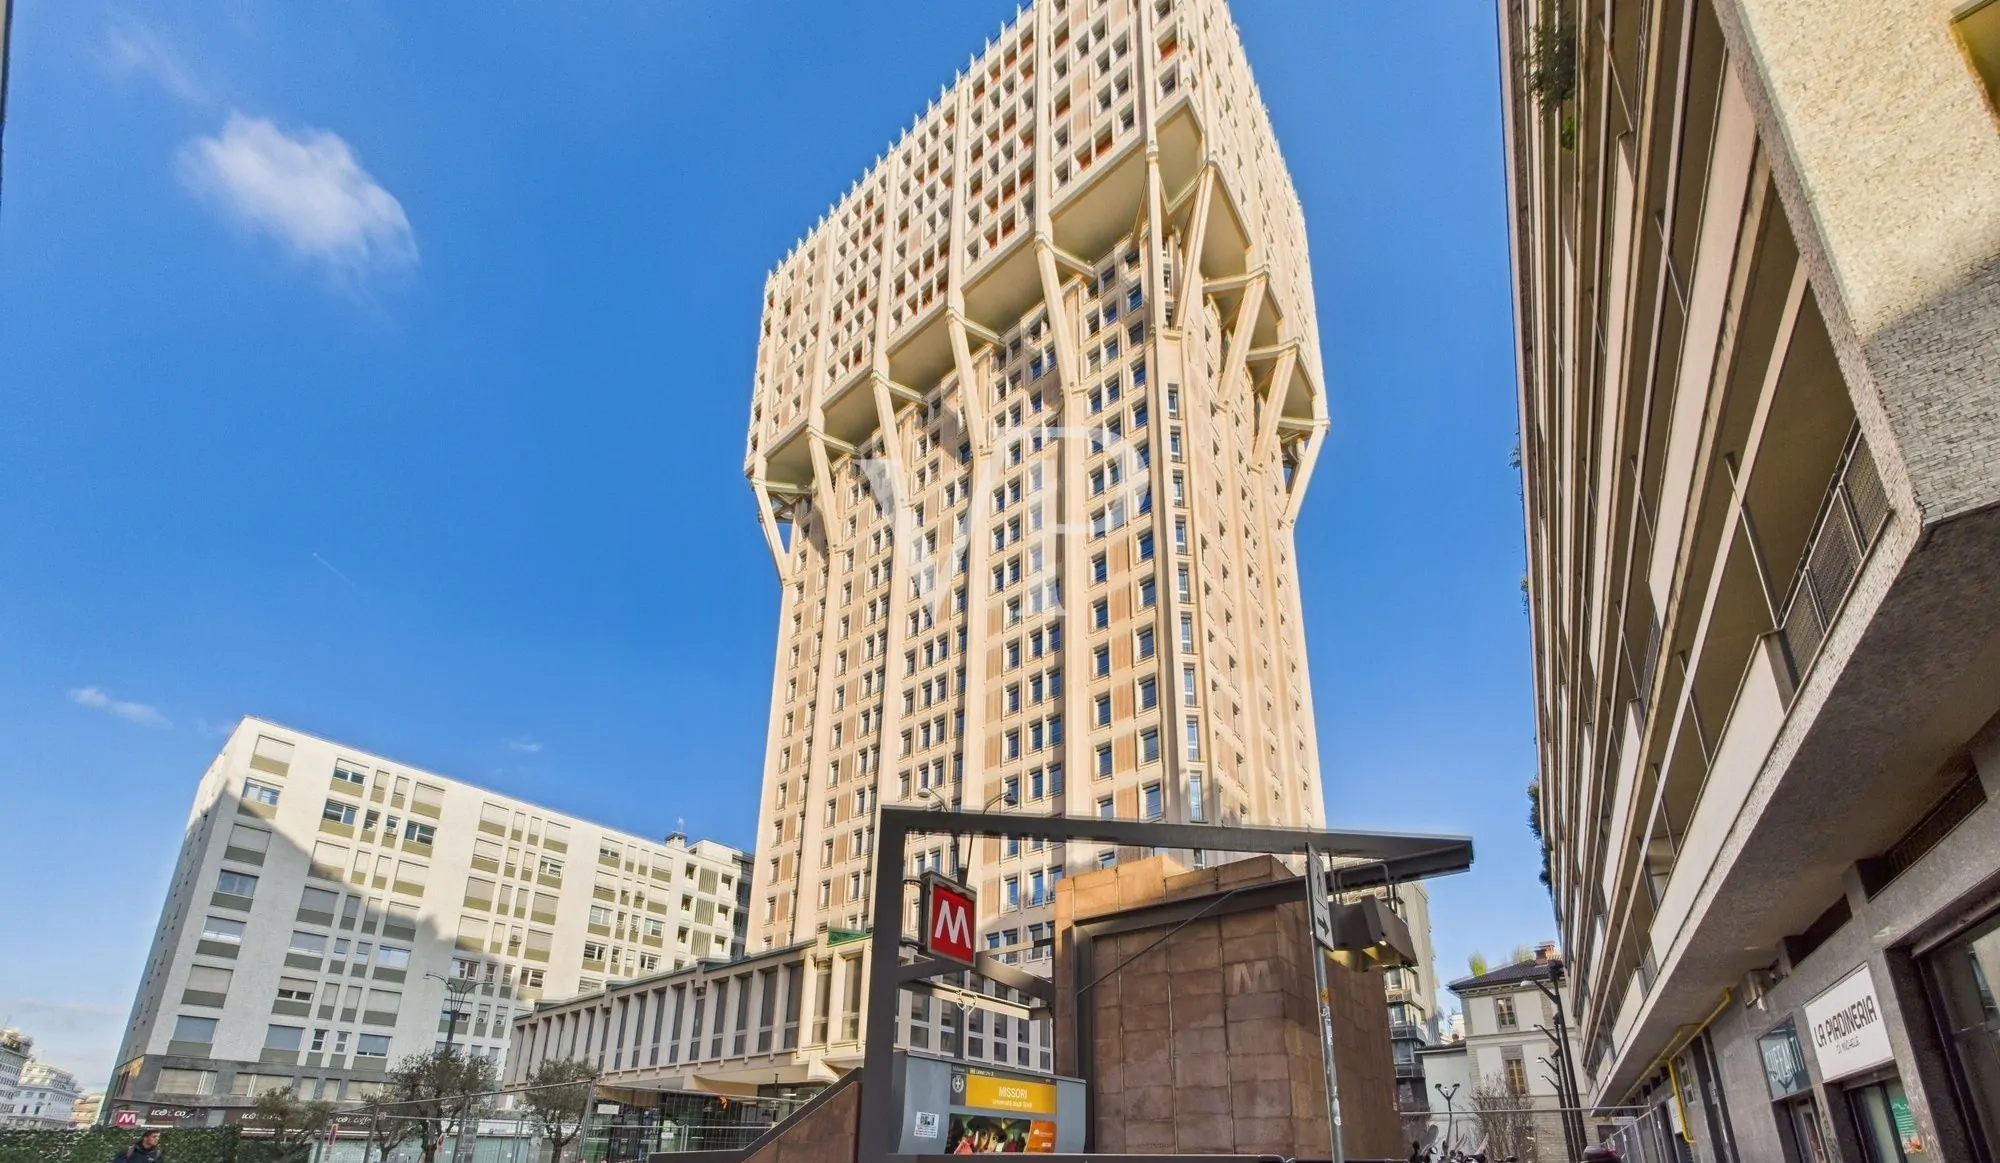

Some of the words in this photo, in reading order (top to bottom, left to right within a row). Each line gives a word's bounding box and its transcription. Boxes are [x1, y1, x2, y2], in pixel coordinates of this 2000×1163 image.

[934, 899, 972, 950] M
[1813, 1023, 1828, 1048] LA
[1824, 995, 1878, 1043] PIADINERIA
[998, 1086, 1028, 1099] MISSORI
[118, 1113, 136, 1123] M
